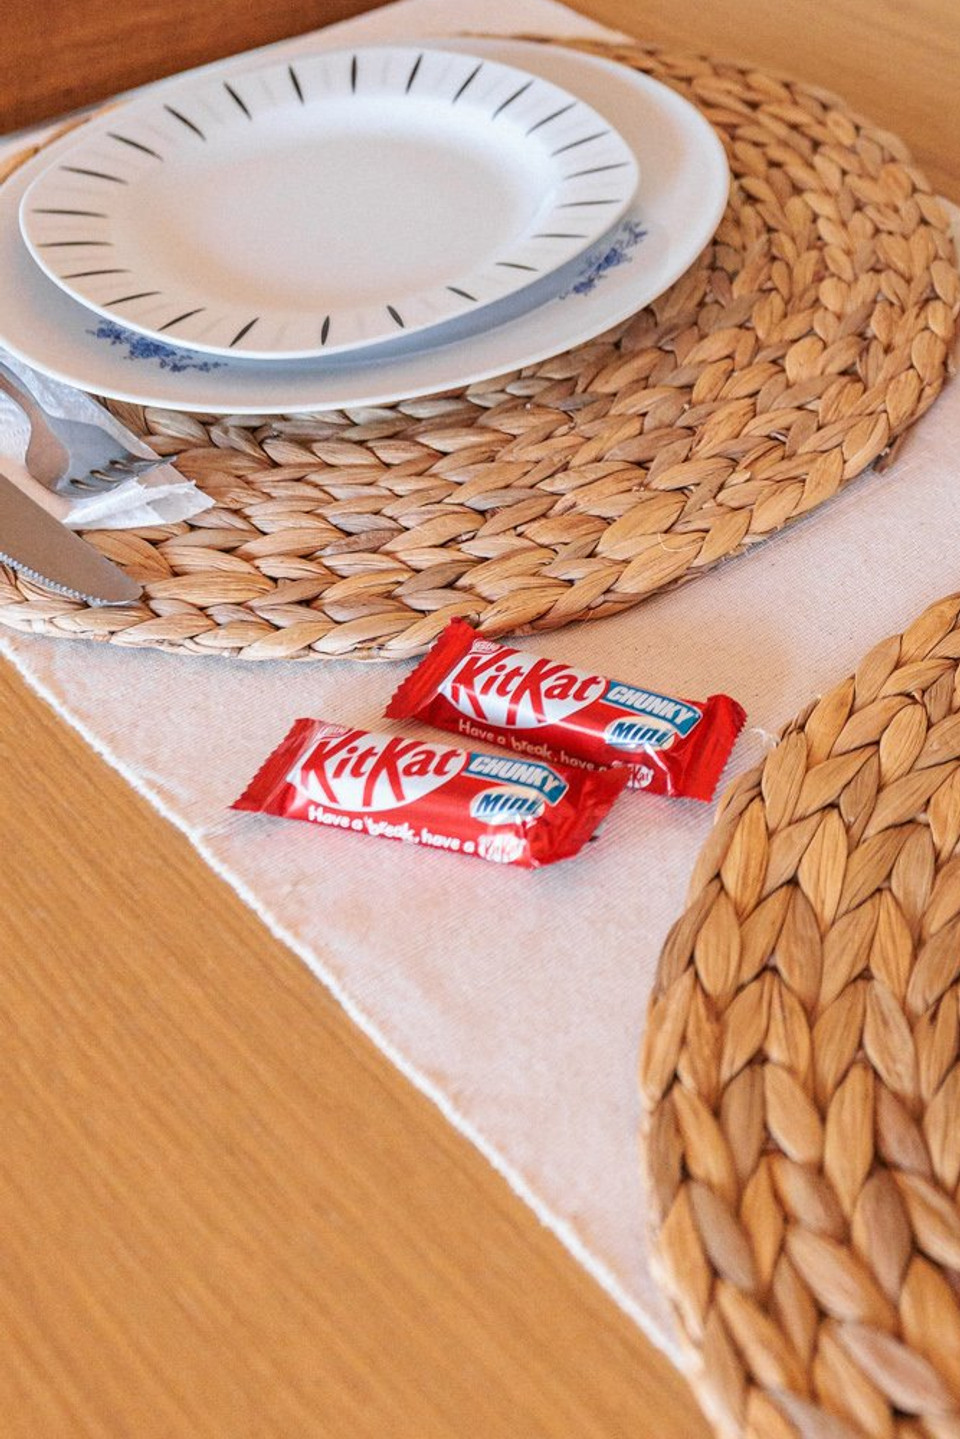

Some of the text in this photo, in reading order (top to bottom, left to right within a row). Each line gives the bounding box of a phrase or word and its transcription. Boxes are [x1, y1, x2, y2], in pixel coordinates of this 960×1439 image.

[451, 647, 601, 726] KitKat
[606, 685, 695, 725] CHUNKY
[458, 718, 494, 741] Have
[496, 735, 506, 745] a
[560, 750, 595, 772] have
[610, 721, 673, 747] Mini
[301, 729, 461, 807] KitKat
[468, 756, 560, 792] CHUNKY
[475, 793, 543, 815] Mini
[308, 804, 350, 828] Have
[351, 817, 363, 831] a
[420, 827, 461, 850] have
[463, 840, 476, 853] a
